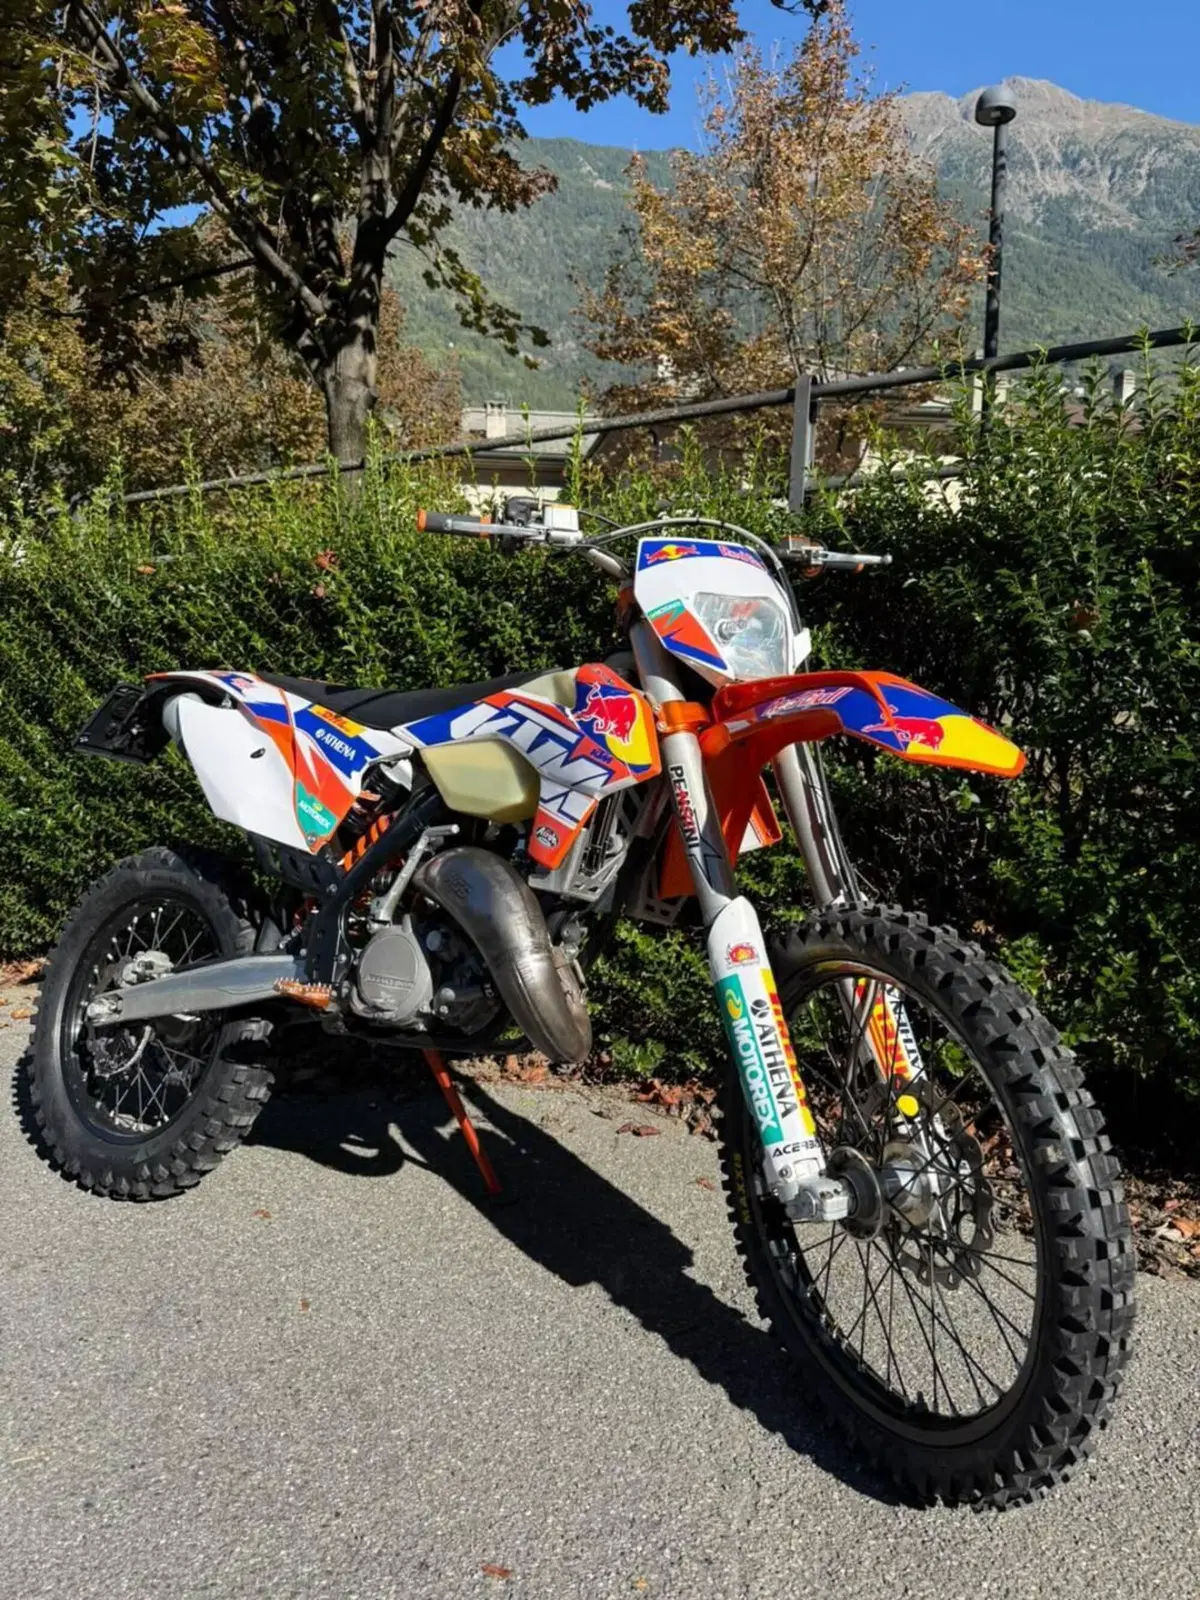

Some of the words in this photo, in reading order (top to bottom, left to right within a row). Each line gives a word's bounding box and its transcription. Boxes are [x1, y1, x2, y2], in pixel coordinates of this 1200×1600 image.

[322, 734, 357, 761] ATHENA
[730, 1017, 778, 1132] MOTOREX
[755, 1022, 799, 1119] ATHENA
